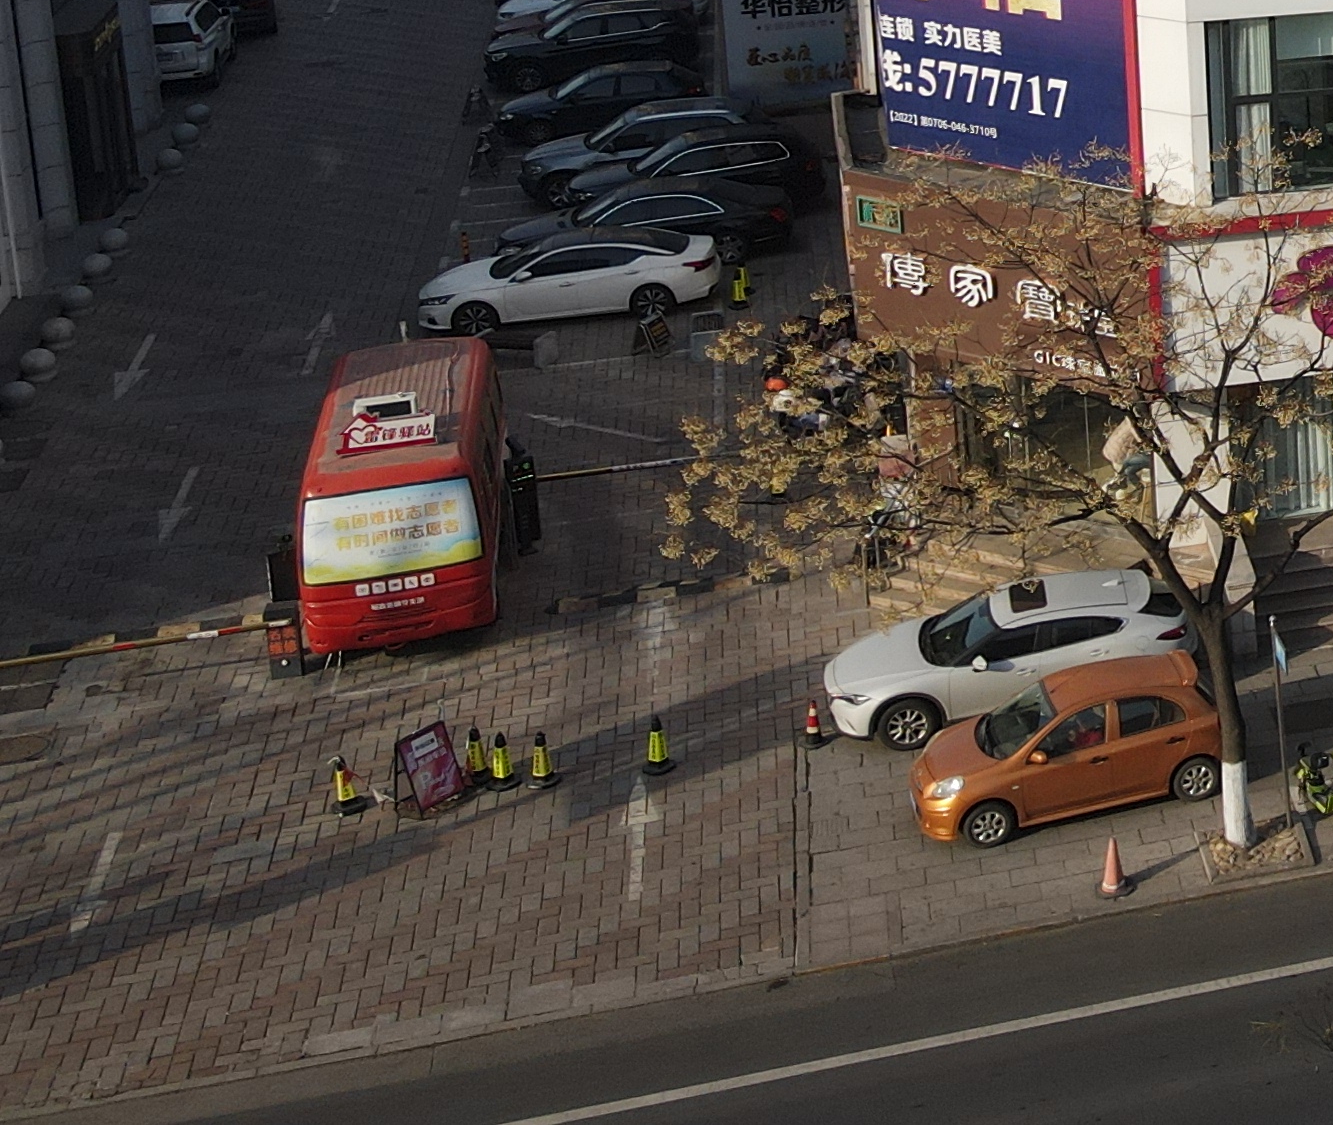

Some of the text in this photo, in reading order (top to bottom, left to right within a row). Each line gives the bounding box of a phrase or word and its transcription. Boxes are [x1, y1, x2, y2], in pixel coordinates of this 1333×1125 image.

[923, 21, 1002, 57] 实力医美
[335, 499, 457, 530] 有困难找志愿者
[337, 520, 459, 550] 有时间做志愿者
